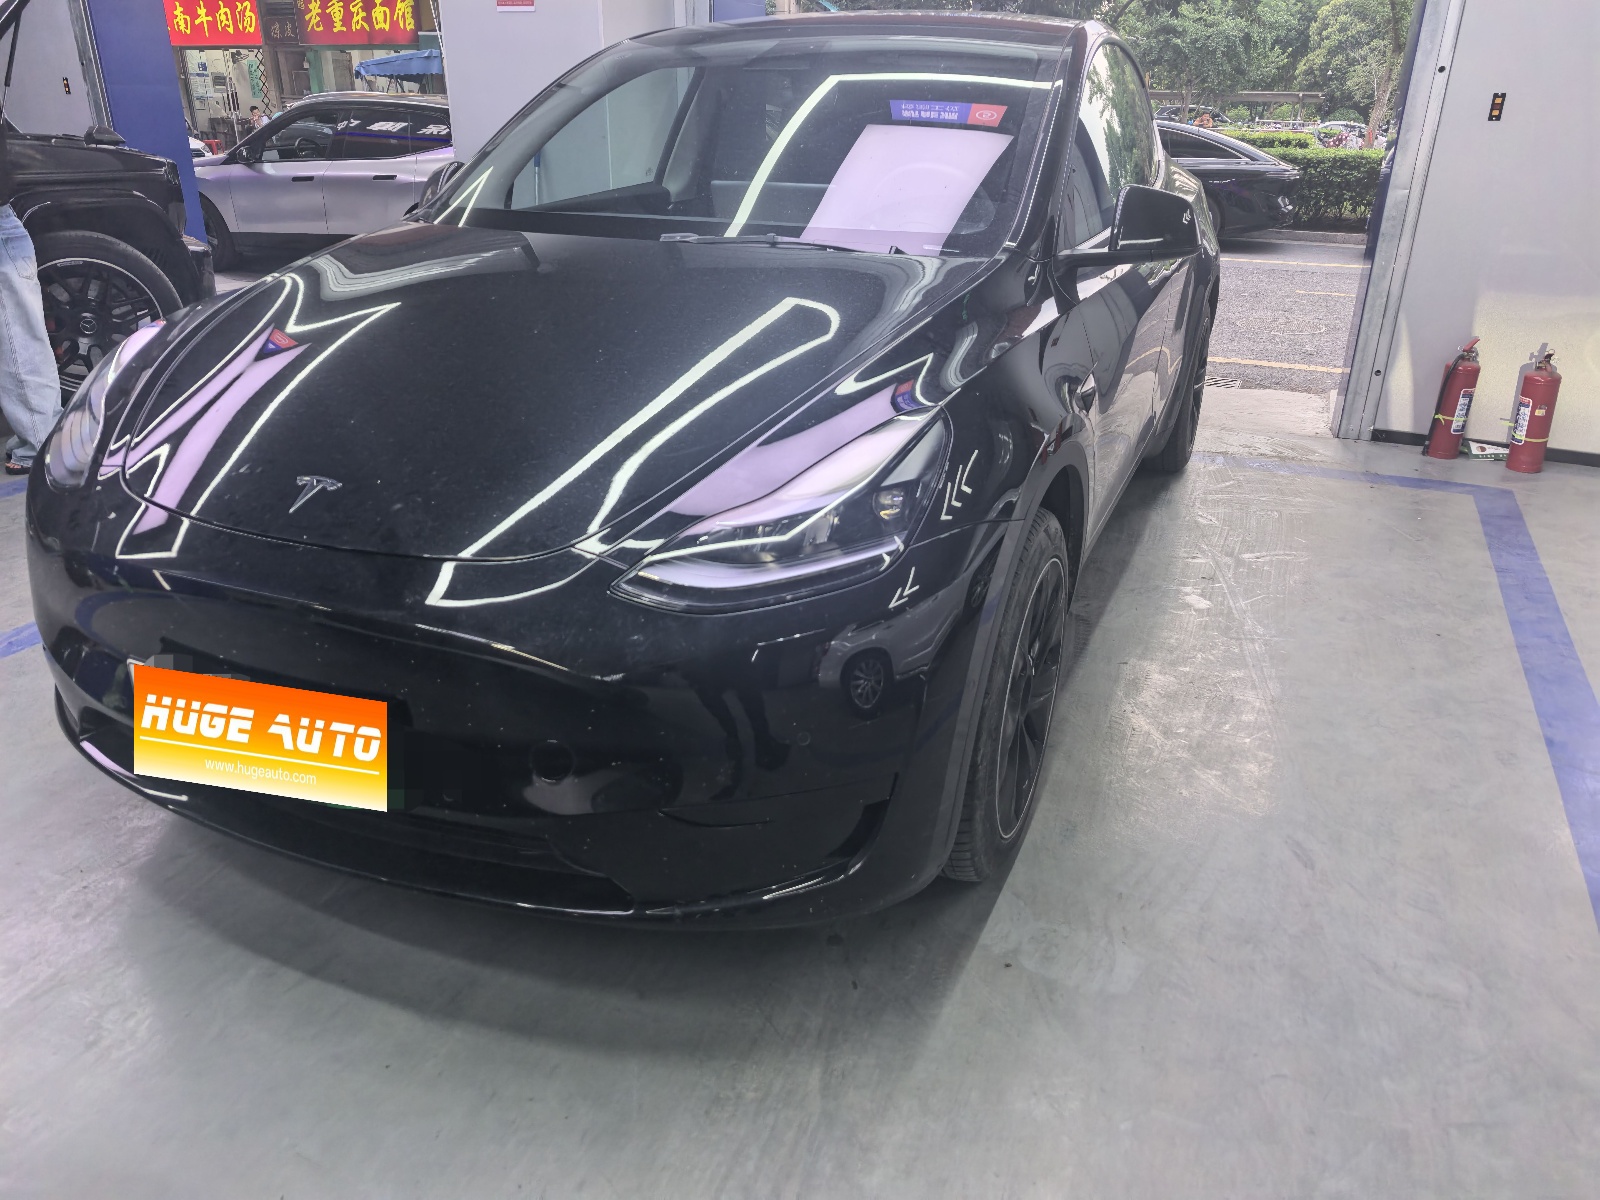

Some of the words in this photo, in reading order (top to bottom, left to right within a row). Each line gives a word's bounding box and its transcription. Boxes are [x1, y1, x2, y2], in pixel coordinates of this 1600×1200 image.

[168, 0, 256, 38] 南牛肉汤
[304, 0, 415, 32] 老重庆面馆
